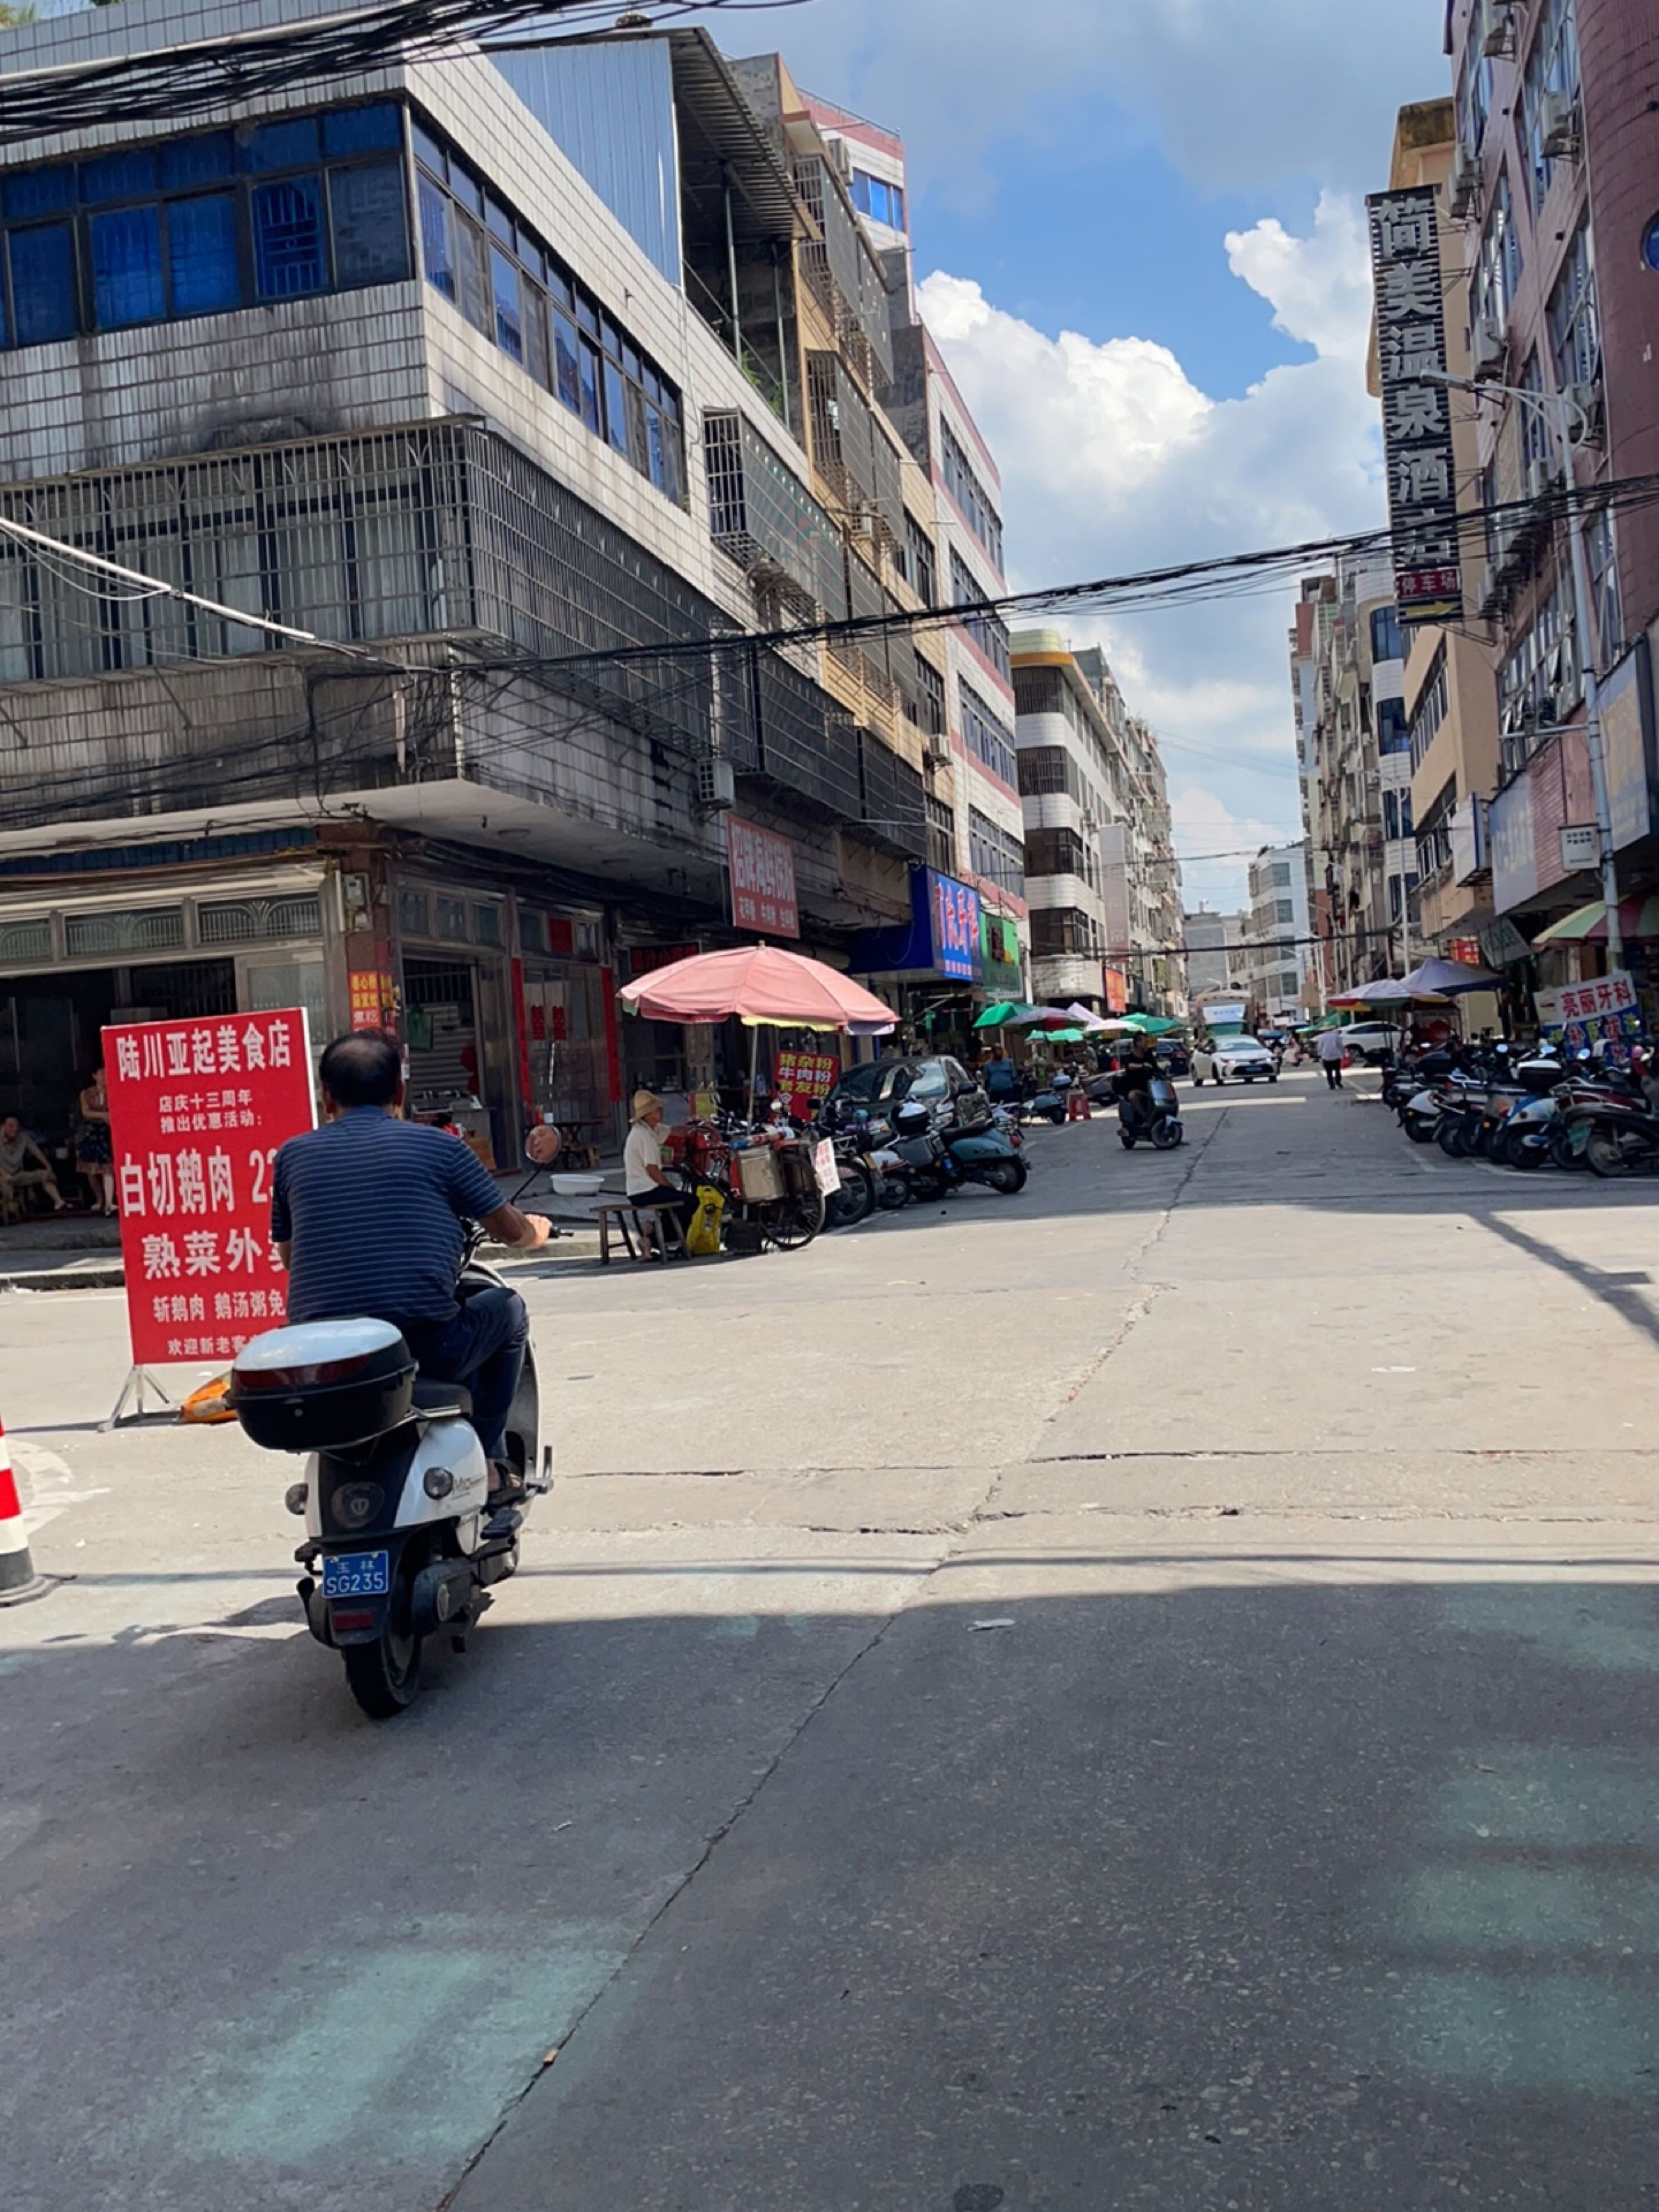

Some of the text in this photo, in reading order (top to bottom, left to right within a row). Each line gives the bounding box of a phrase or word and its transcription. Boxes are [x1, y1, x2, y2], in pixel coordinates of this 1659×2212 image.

[1401, 572, 1457, 595] 停车场
[1560, 978, 1632, 1019] 亮丽牙科
[116, 1019, 291, 1081] 陆川亚起美食店
[778, 1067, 831, 1082] 牛肉粉
[159, 1089, 253, 1113] 店庆十三周年
[119, 1146, 235, 1217] 白切鹅肉
[152, 1293, 204, 1323] 斩鹅肉
[166, 1334, 256, 1356] 欢迎新老客
[336, 1559, 375, 1575] 玉林
[326, 1571, 385, 1594] SG235
